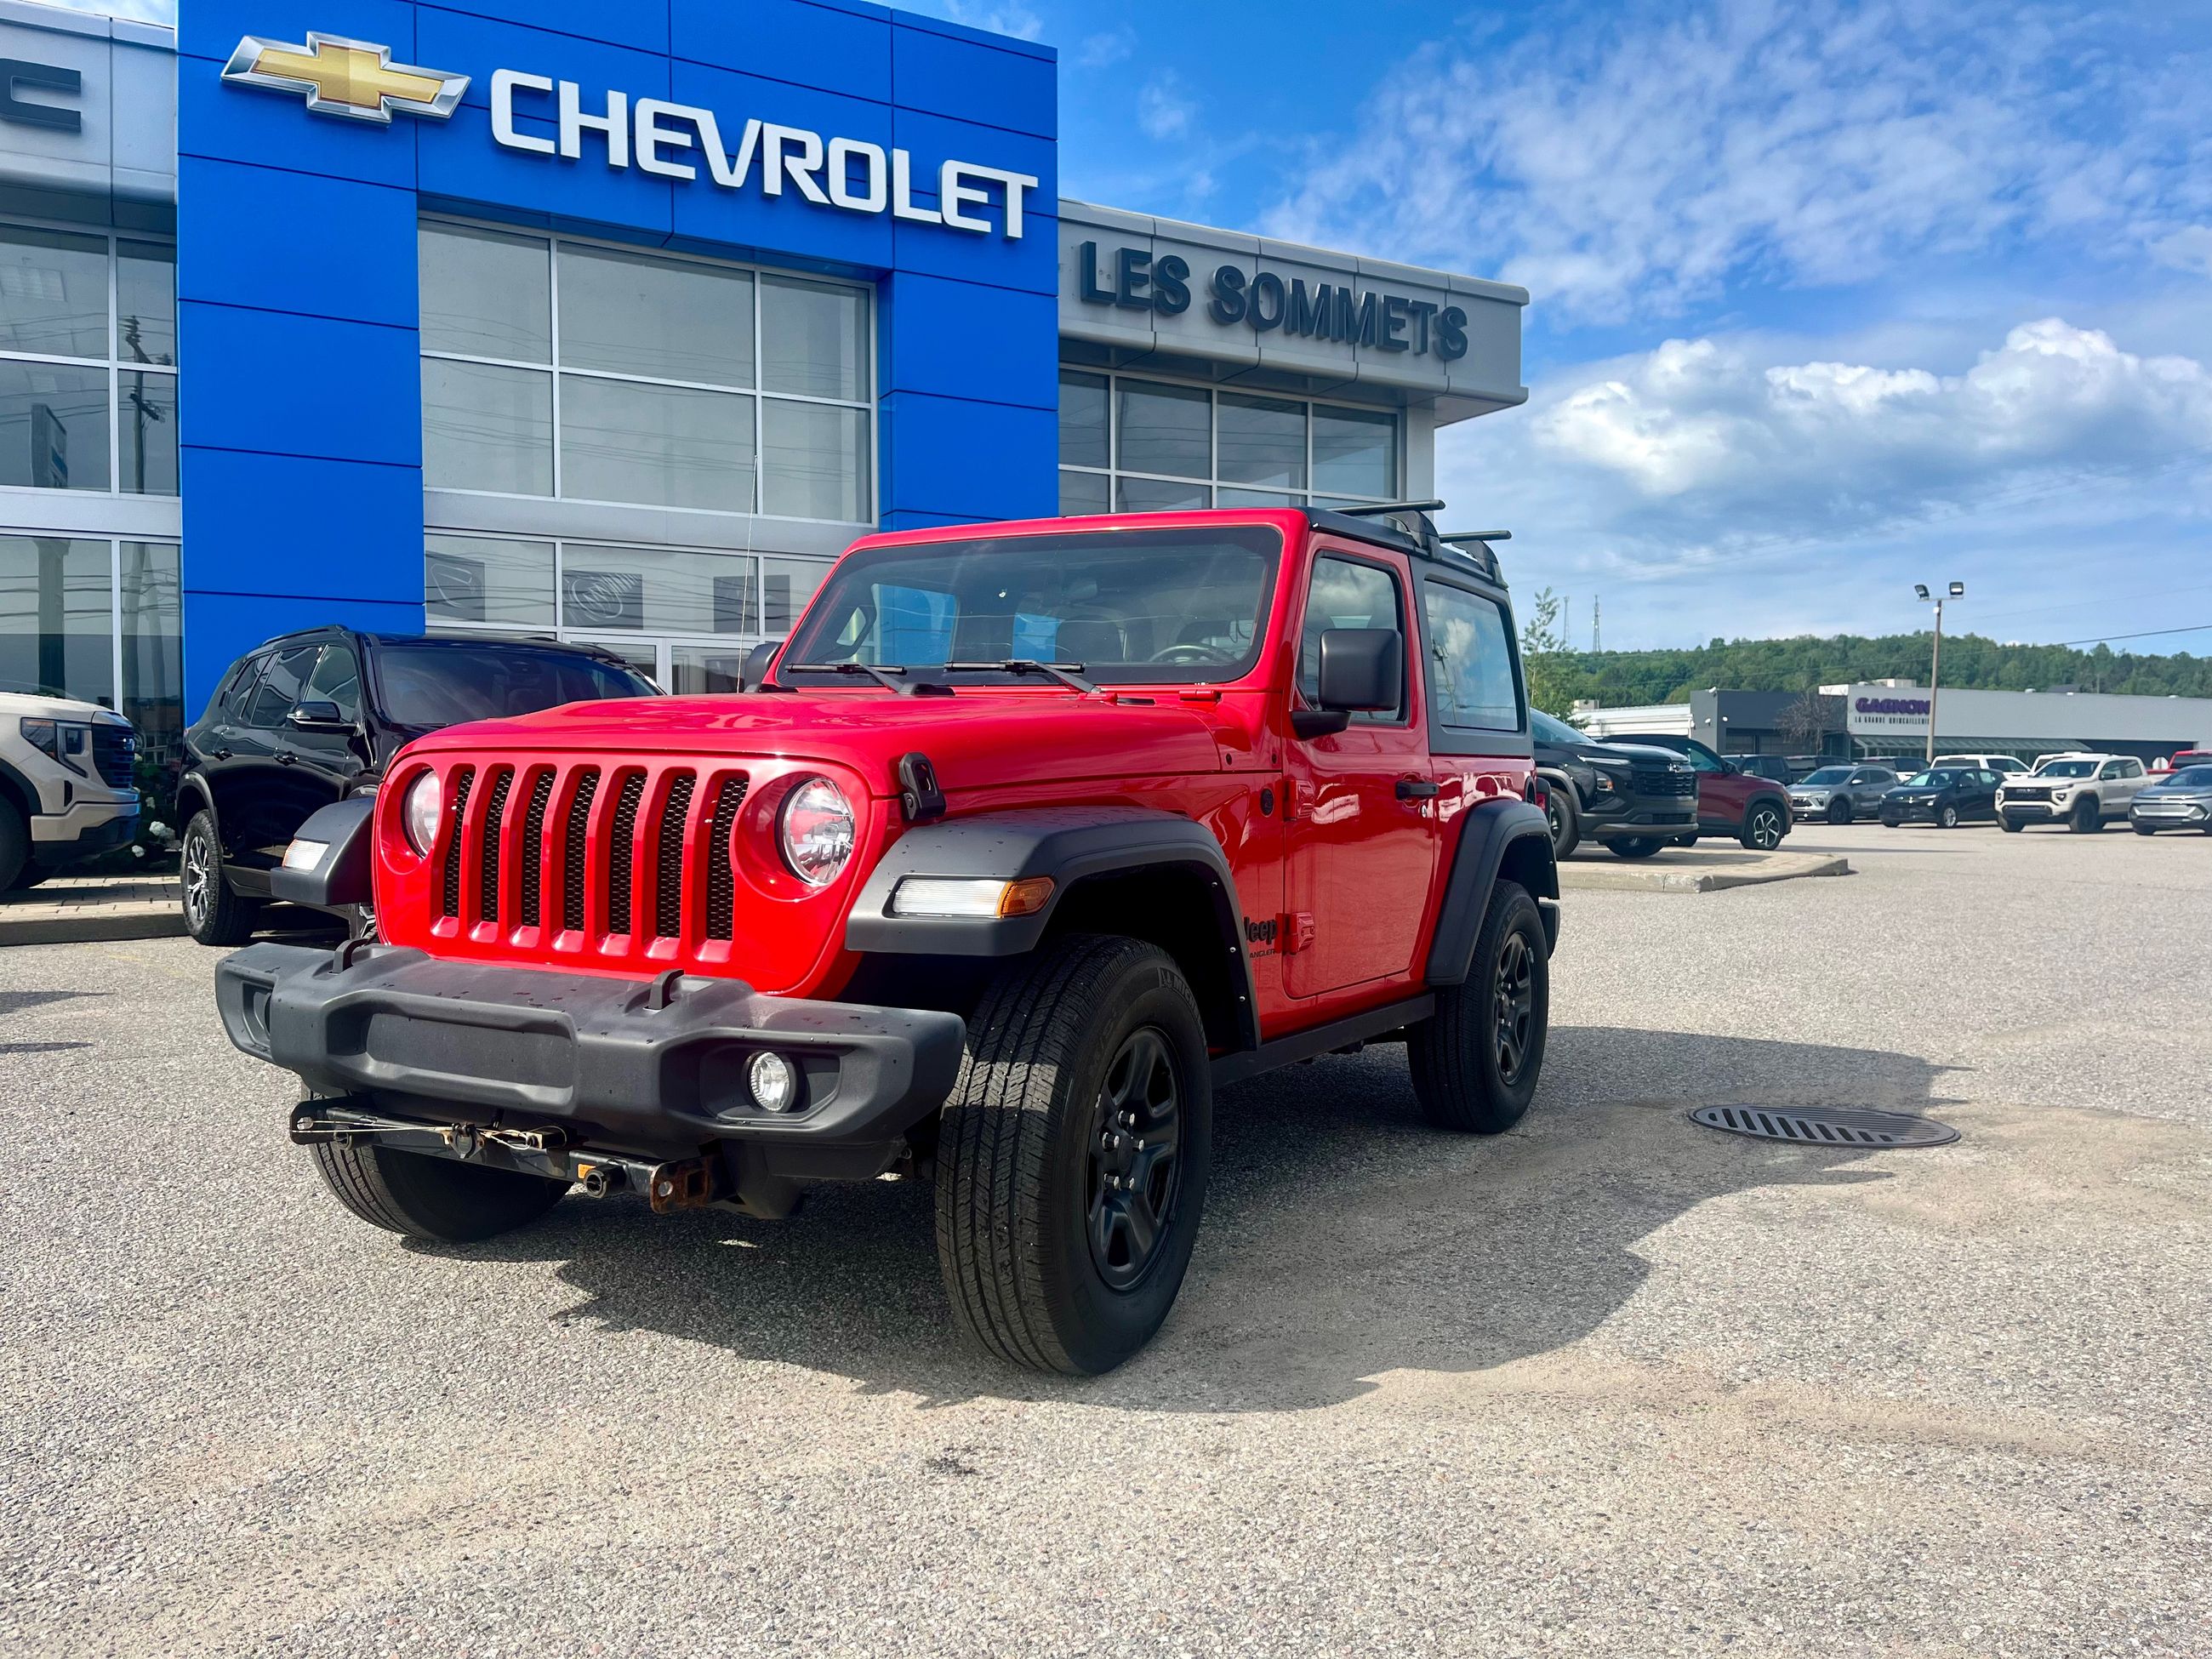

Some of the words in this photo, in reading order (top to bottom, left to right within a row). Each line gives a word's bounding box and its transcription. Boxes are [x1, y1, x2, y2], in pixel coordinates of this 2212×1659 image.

[491, 68, 1039, 239] CHEVROLET
[1080, 241, 1191, 316] LES
[1207, 265, 1468, 361] SOMMETS
[1855, 697, 1930, 715] GAGNON
[1249, 949, 1276, 959] ANGLER
